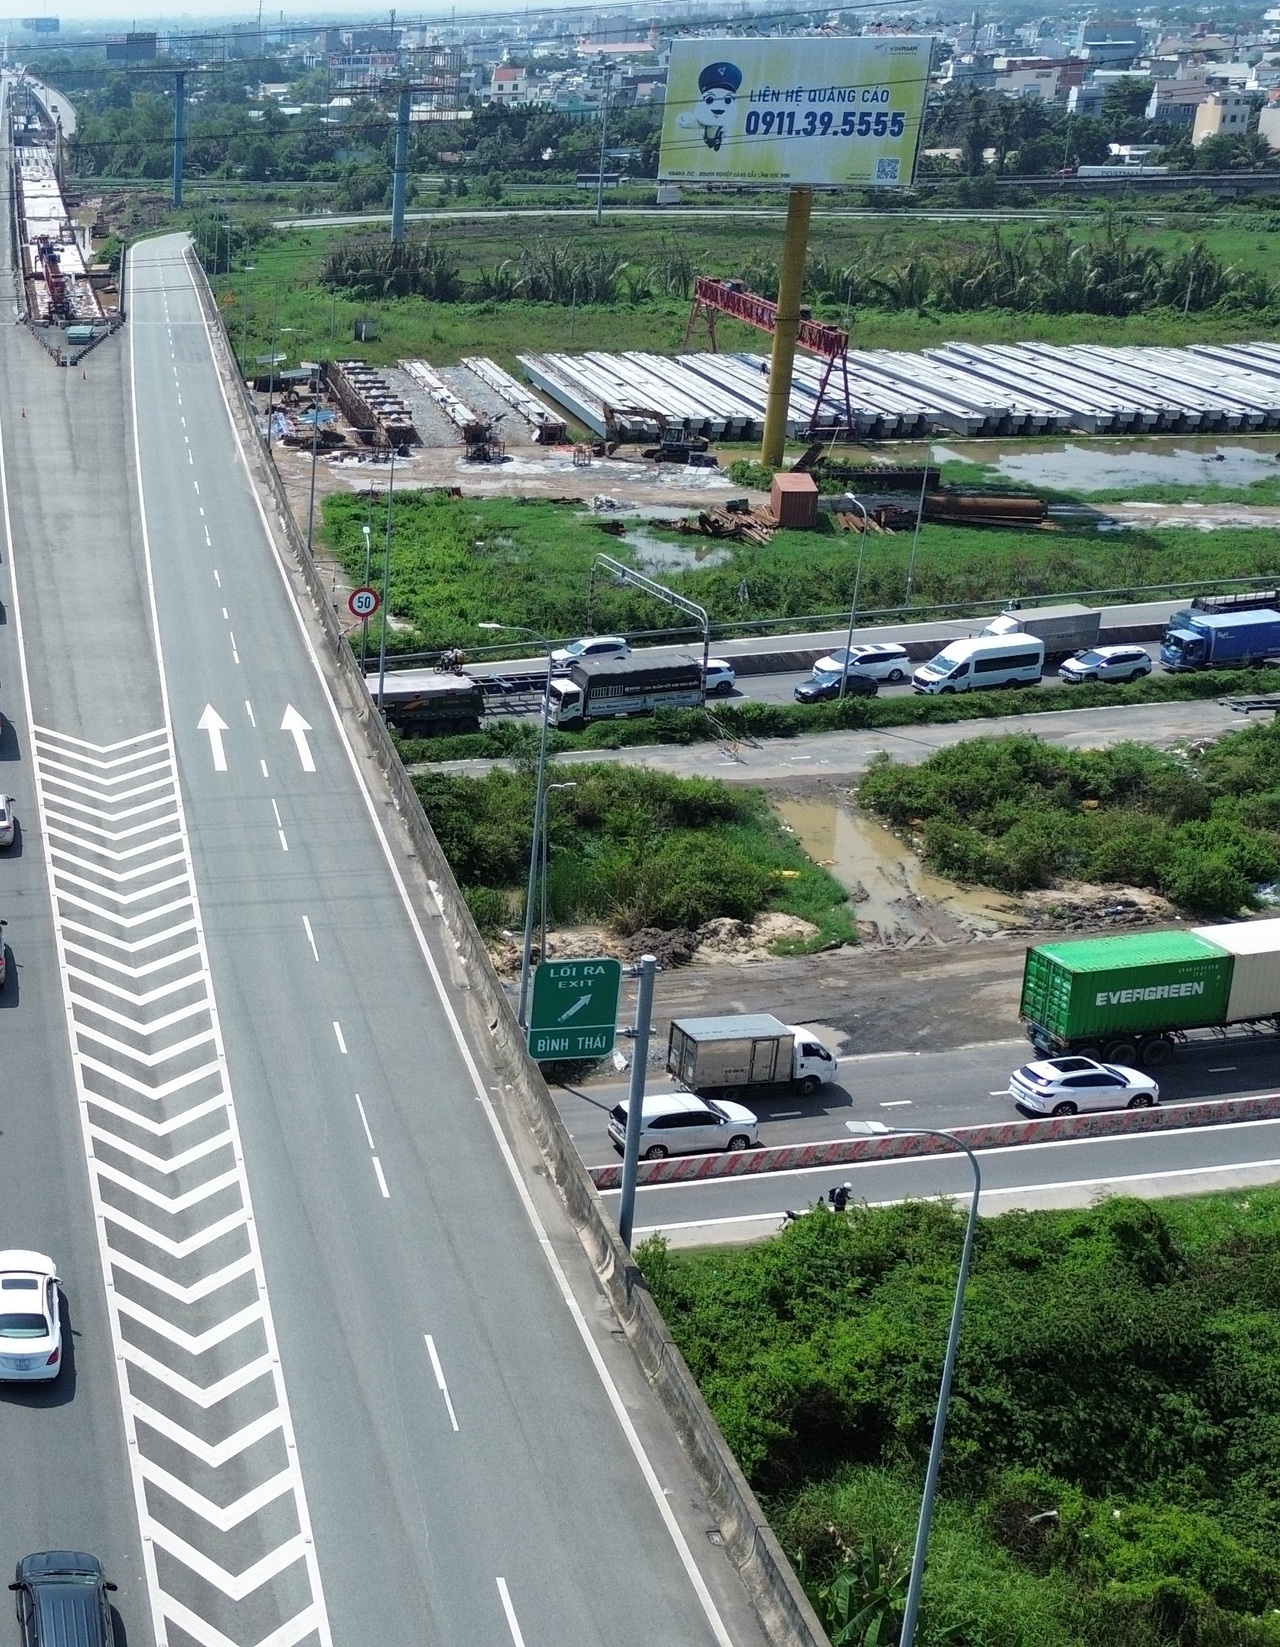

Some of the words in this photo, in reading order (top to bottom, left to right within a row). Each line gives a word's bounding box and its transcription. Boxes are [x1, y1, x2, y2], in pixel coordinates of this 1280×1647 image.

[749, 85, 780, 103] LIÊN
[785, 85, 803, 107] HỆ
[807, 85, 856, 104] QUẢNG
[861, 85, 890, 103] CÁO
[745, 110, 906, 138] 0911.39.5555
[357, 596, 371, 609] 50
[549, 964, 577, 978] LỐI
[583, 965, 606, 976] RA
[558, 979, 596, 988] EXIT
[1095, 981, 1205, 1006] EVERGREEN
[537, 1035, 569, 1052] BÌNH
[577, 1033, 606, 1050] THÁI
